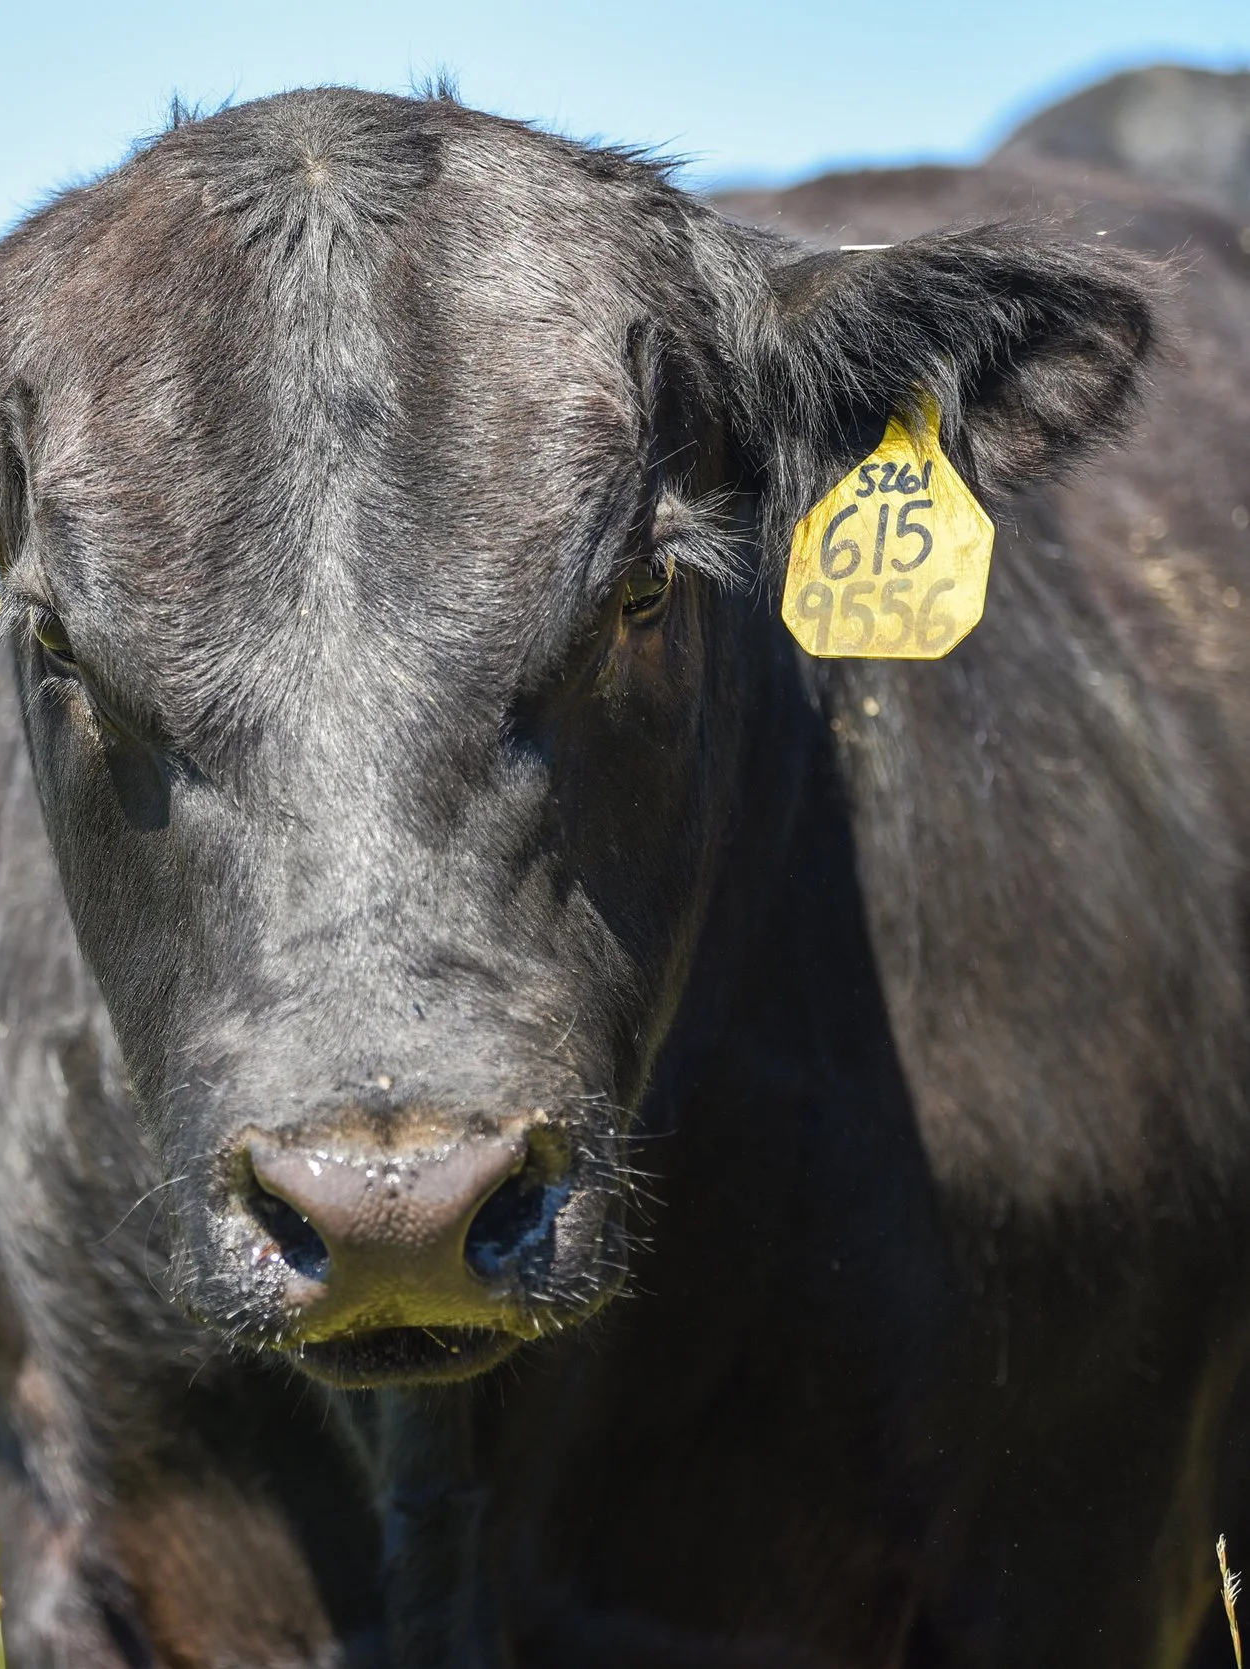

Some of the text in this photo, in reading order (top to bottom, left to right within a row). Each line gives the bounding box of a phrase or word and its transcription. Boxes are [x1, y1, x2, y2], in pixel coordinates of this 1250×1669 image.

[855, 460, 933, 498] 5261
[820, 499, 933, 581] 615
[795, 577, 956, 653] 9556
